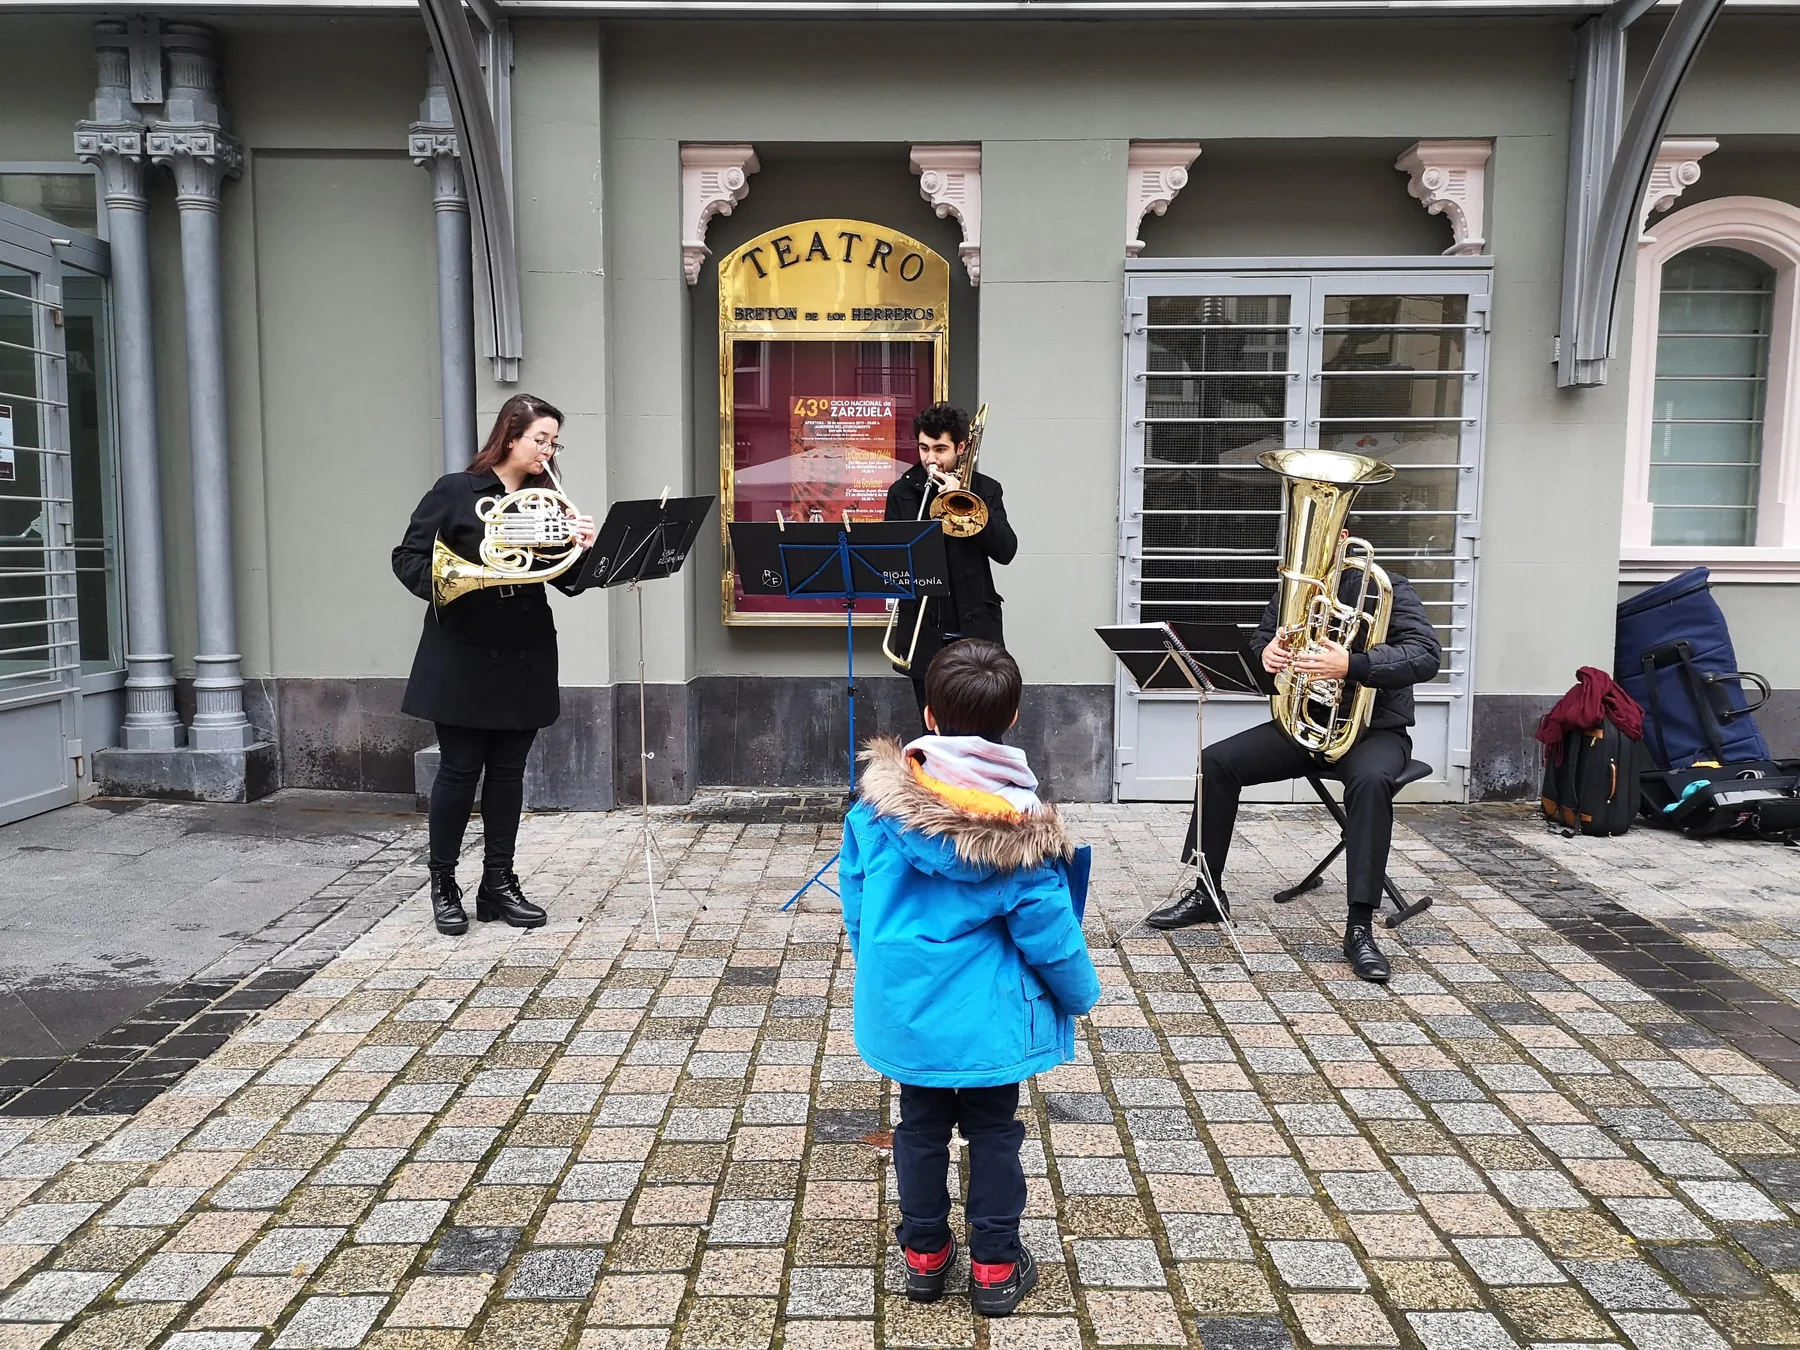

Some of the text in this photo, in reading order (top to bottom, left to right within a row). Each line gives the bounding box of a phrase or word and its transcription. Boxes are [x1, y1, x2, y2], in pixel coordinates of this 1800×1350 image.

[741, 231, 925, 282] TEATRO
[734, 307, 934, 321] BRETON DE LOS HERREROS
[830, 406, 892, 417] ZARZUELA
